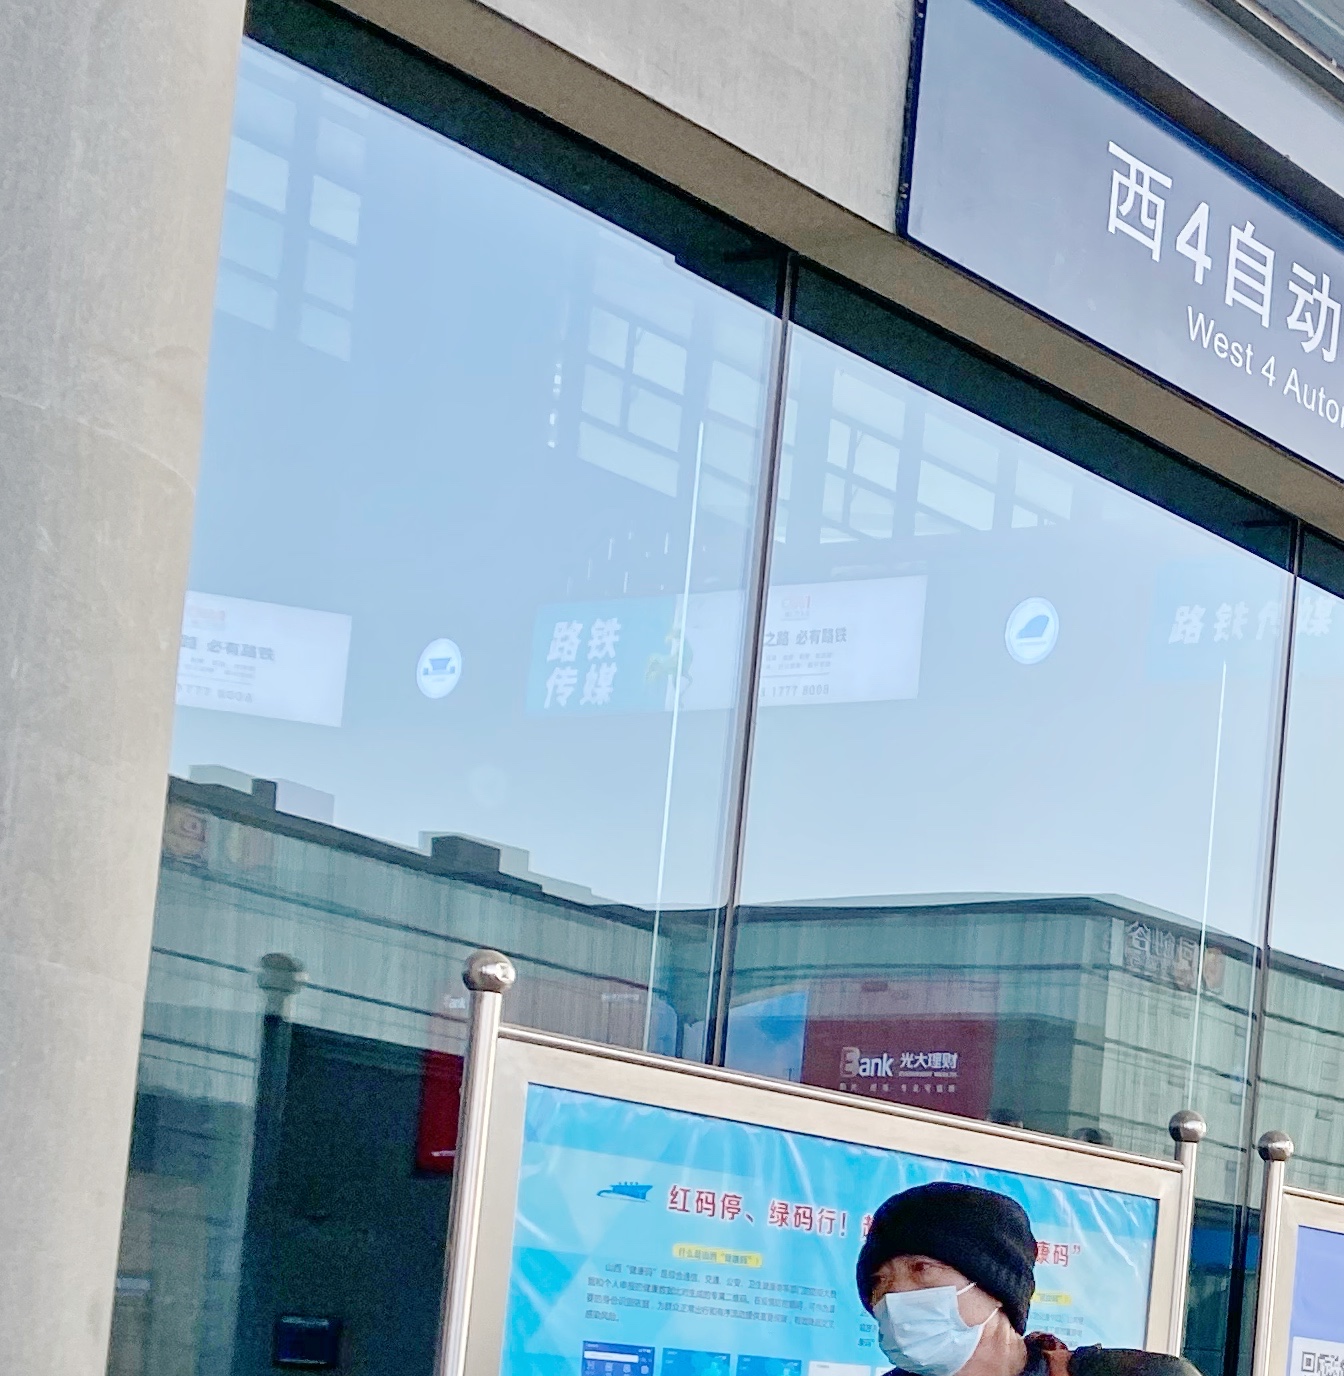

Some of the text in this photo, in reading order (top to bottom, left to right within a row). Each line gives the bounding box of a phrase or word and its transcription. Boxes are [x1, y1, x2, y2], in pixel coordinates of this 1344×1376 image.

[1187, 306, 1253, 375] West
[1261, 355, 1276, 387] 4
[547, 618, 622, 662] 路铁
[544, 662, 617, 709] 传媒
[900, 1052, 957, 1069] 光大理财
